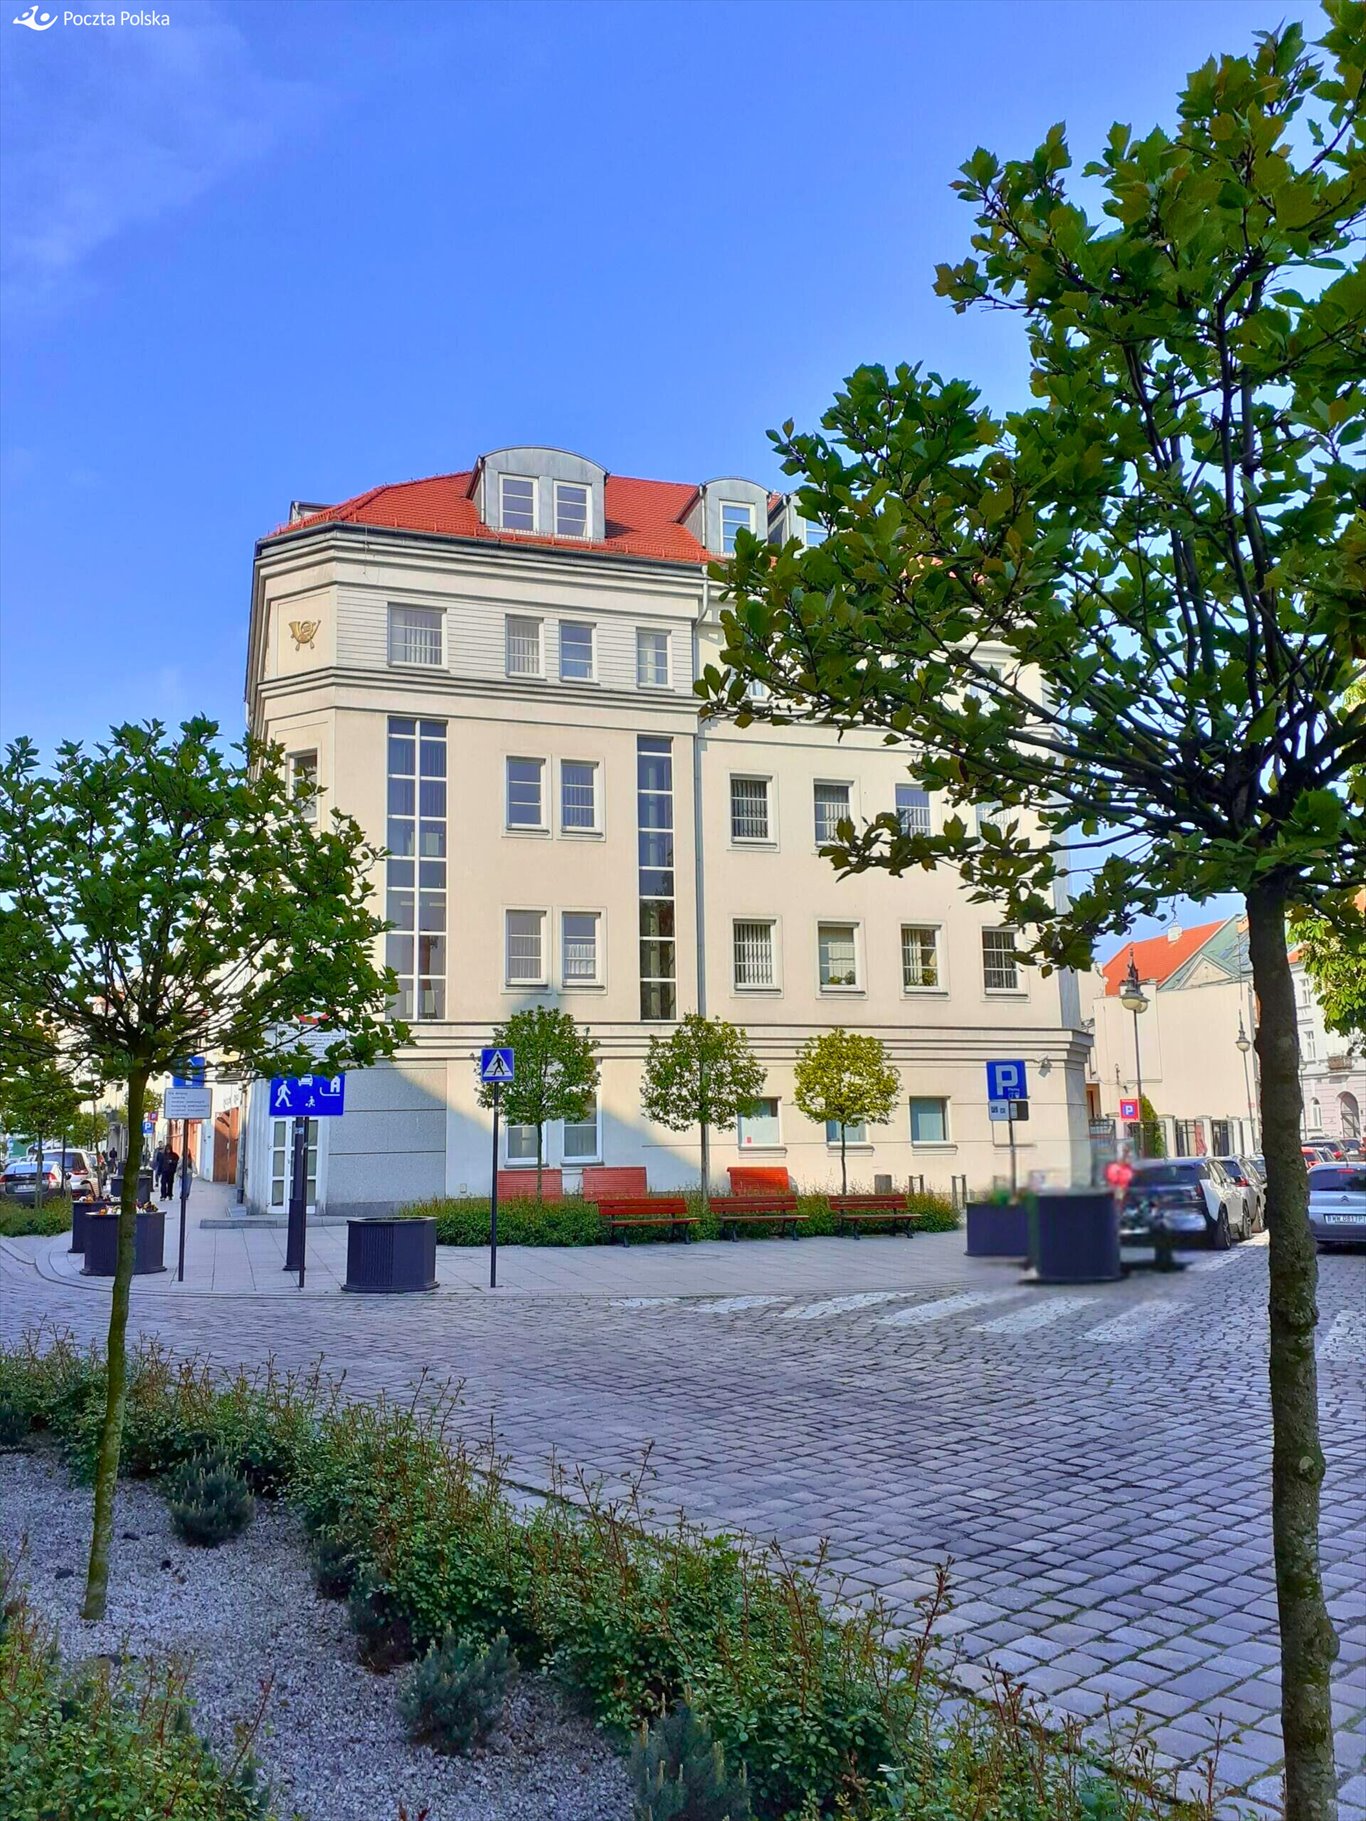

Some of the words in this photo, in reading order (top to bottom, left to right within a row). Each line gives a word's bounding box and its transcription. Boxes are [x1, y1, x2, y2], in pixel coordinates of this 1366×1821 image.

[995, 1064, 1019, 1096] P
[1125, 1105, 1134, 1116] P
[144, 1122, 152, 1131] P
